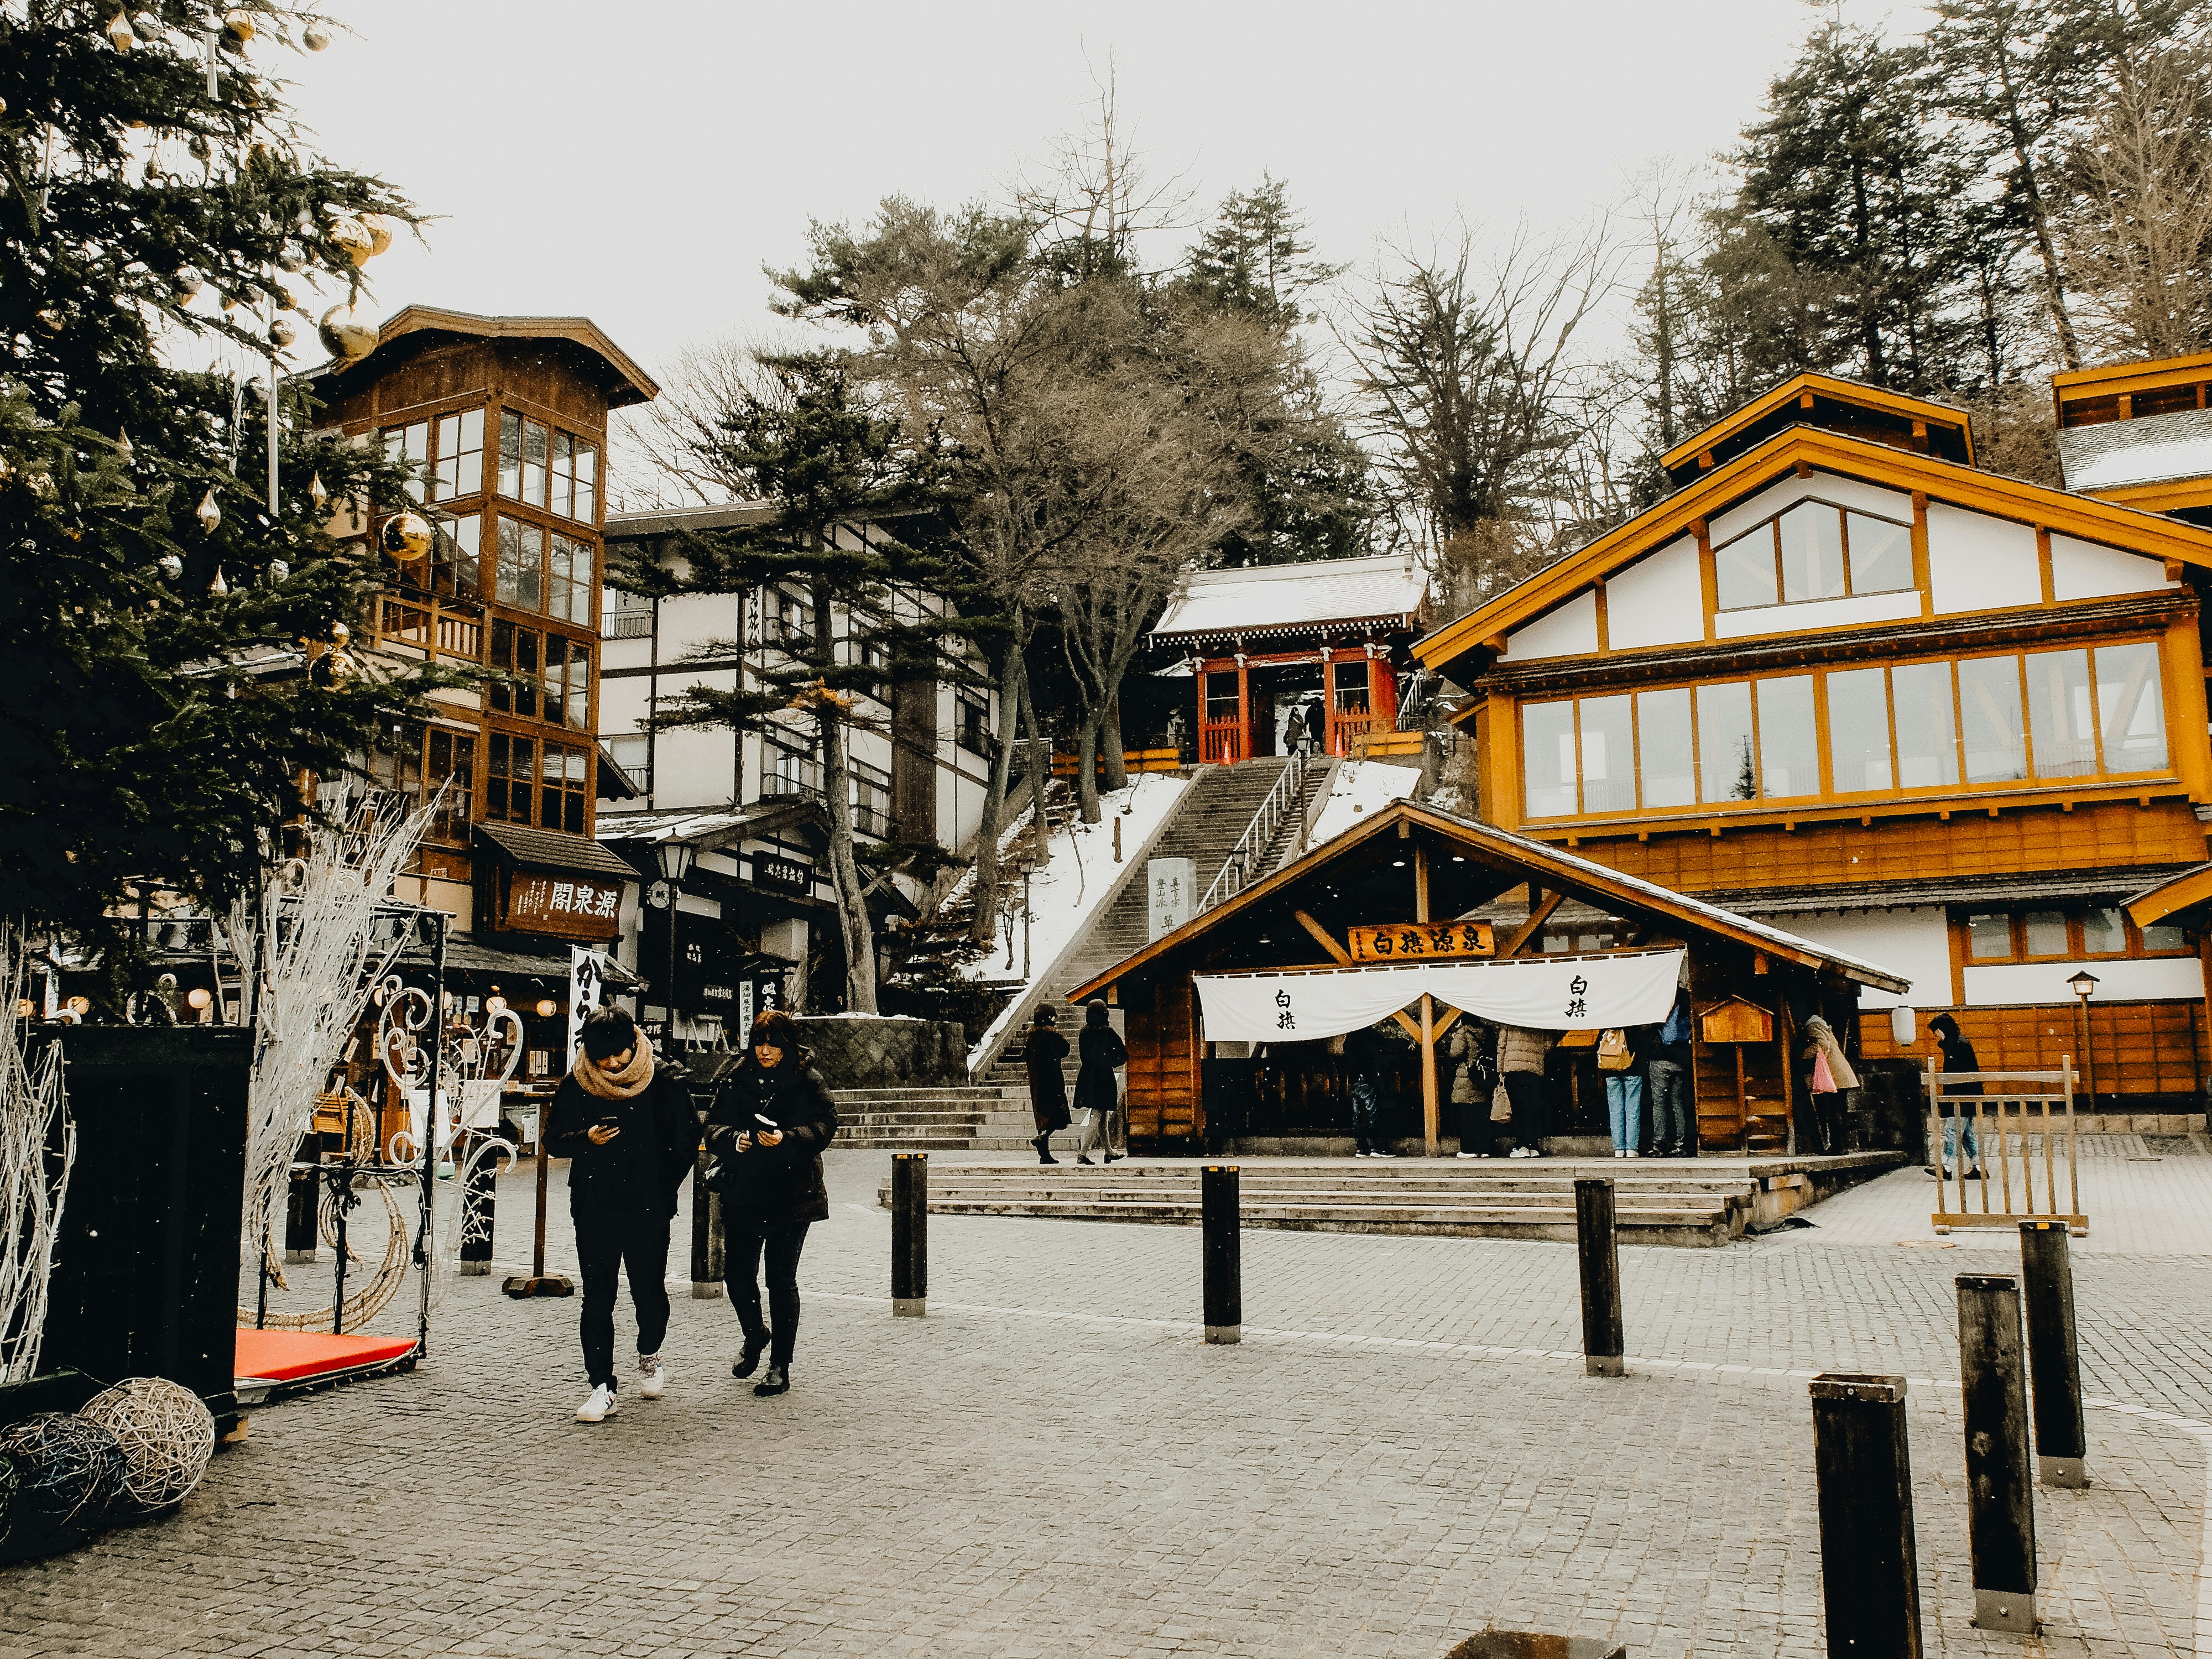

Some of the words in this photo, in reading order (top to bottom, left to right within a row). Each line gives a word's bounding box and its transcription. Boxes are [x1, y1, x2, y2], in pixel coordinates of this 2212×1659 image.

[1161, 914, 1176, 935] 草
[1275, 989, 1296, 1030] 白旗
[1564, 975, 1588, 1018] 白旗
